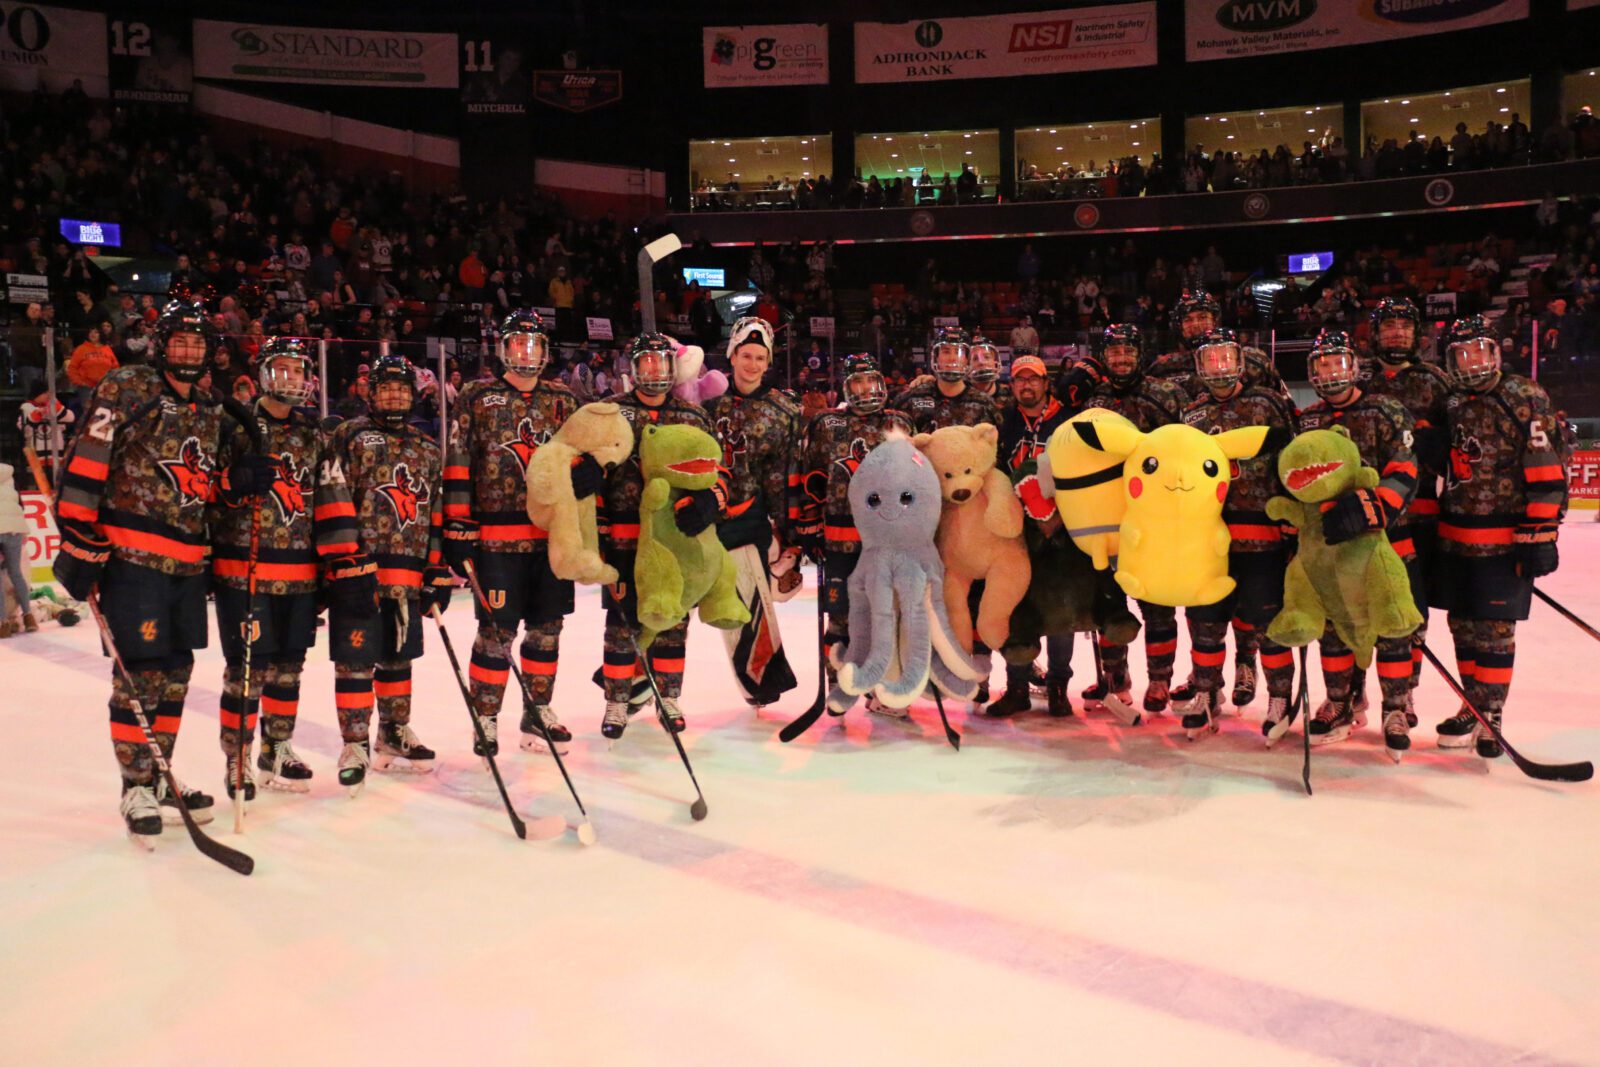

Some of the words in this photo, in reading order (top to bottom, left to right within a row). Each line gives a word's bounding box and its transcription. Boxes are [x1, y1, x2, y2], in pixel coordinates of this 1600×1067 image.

[1232, 0, 1300, 23] MVM
[0, 5, 50, 51] O
[1014, 24, 1067, 48] NSI
[1075, 22, 1114, 33] Northern
[1117, 19, 1145, 29] Safety
[1084, 32, 1125, 42] Industrial
[111, 20, 151, 56] 12
[271, 32, 423, 59] STANDARD
[1197, 37, 1239, 48] Mohawk
[1241, 34, 1271, 45] Valley
[464, 40, 494, 72] 11
[872, 49, 987, 65] ADIRONDACK
[1024, 48, 1136, 64] northernsafety.com
[906, 65, 954, 77] BANK
[467, 104, 527, 113] MITCHELL
[89, 406, 116, 442] 2
[1530, 420, 1549, 447] 5
[488, 589, 507, 610] U
[129, 700, 169, 772] BAUER
